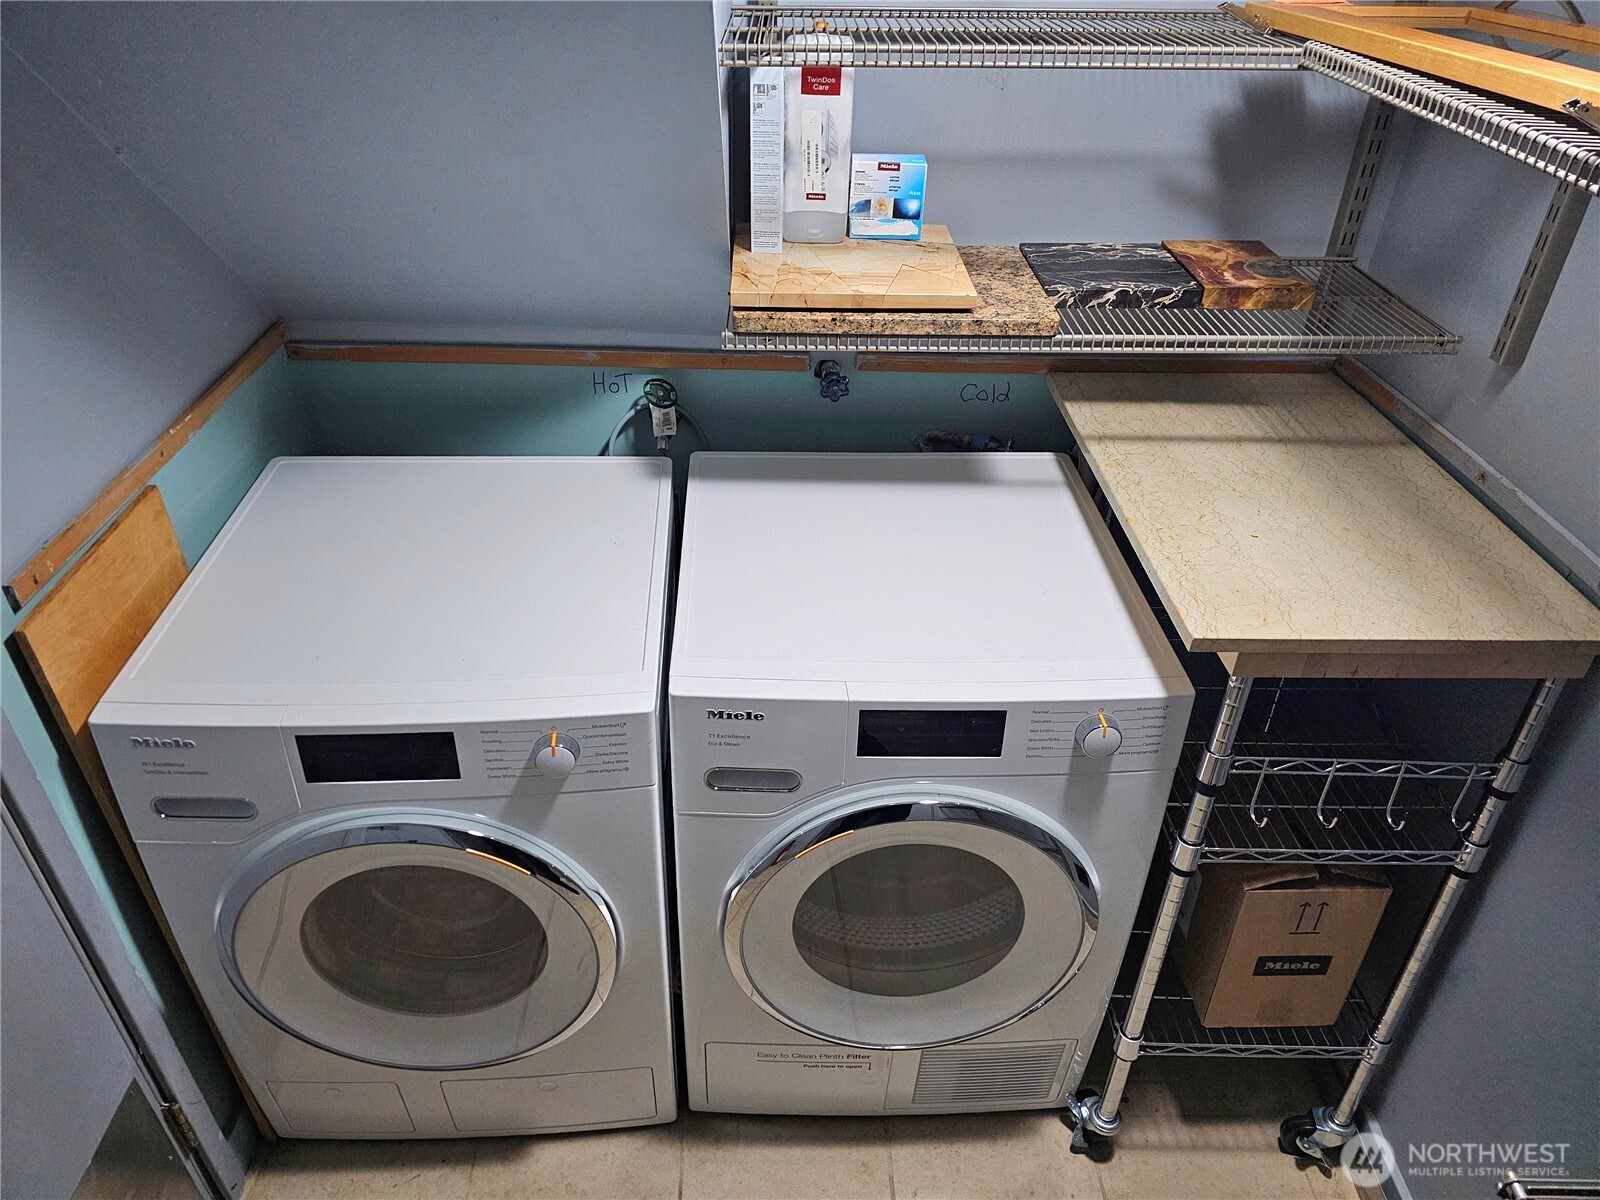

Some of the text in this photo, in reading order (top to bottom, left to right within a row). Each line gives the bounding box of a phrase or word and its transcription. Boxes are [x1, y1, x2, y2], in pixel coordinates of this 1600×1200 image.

[960, 381, 1010, 403] Cold
[706, 709, 765, 721] Miele
[130, 737, 196, 749] Miele
[1264, 961, 1320, 970] Miele
[757, 1052, 778, 1060] Easy
